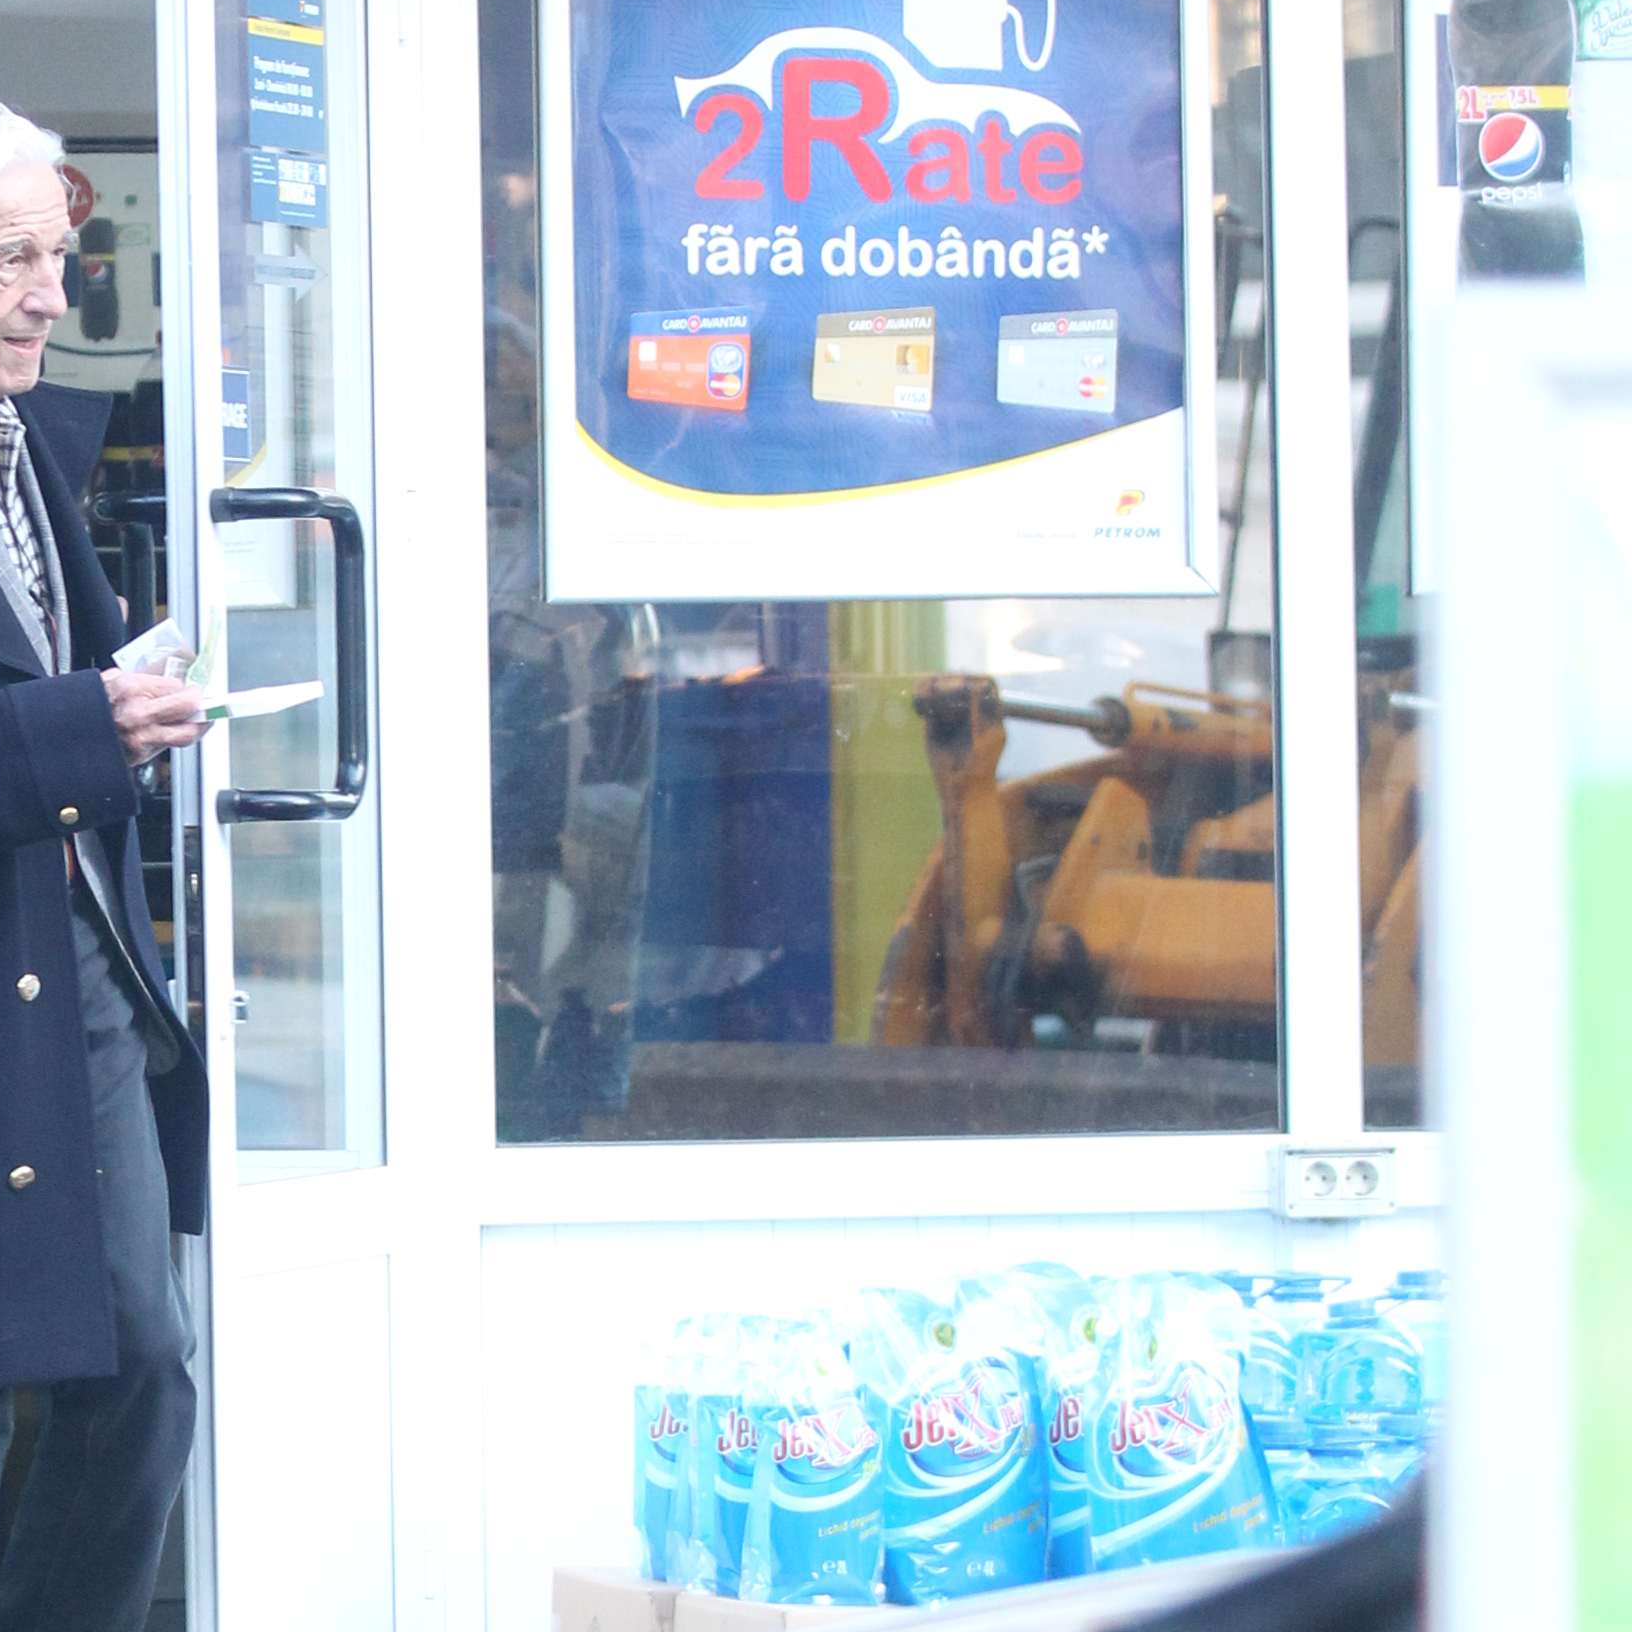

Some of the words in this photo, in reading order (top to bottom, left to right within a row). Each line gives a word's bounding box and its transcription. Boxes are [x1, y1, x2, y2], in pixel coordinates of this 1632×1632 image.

[1458, 86, 1485, 120] 2L
[1481, 182, 1543, 206] pepsi
[662, 320, 687, 330] CARD
[699, 315, 747, 329] AVANTAJ
[848, 320, 873, 331] CARD
[885, 317, 932, 329] AVANTAJ
[1032, 321, 1055, 333] CARD
[1068, 319, 1113, 332] AVANTAJ
[898, 390, 927, 404] VISA
[1094, 526, 1161, 539] PETROM
